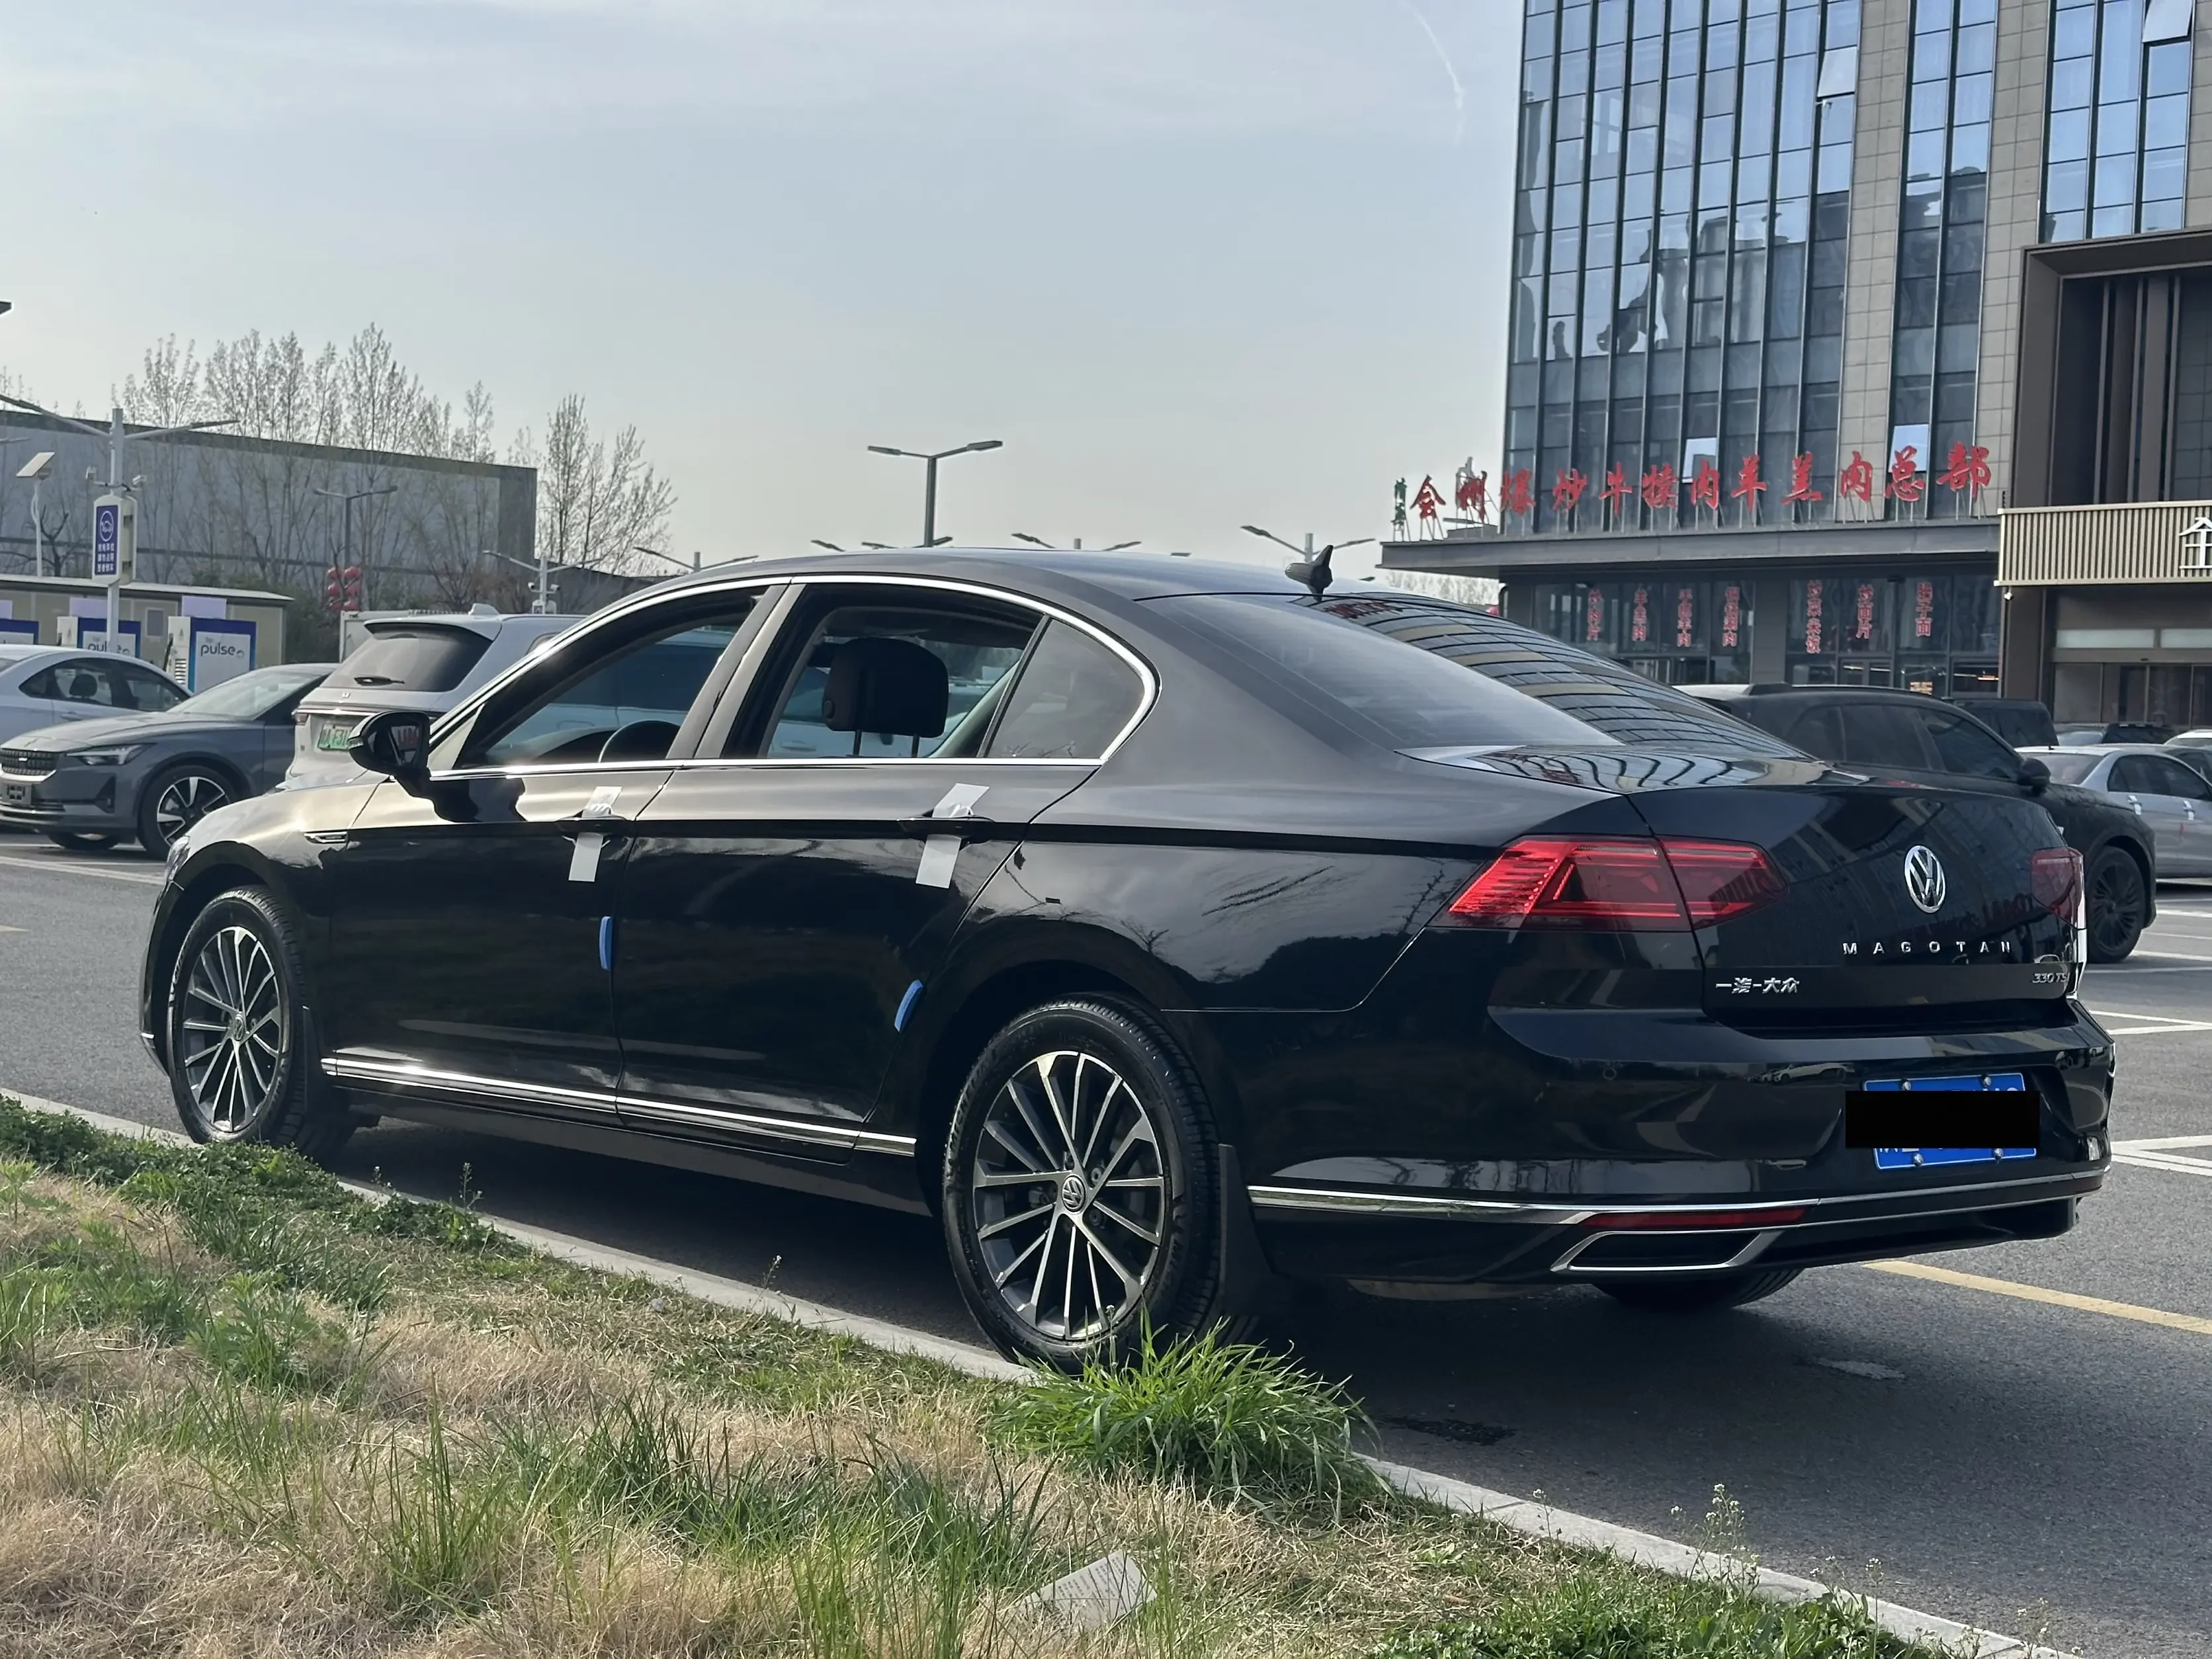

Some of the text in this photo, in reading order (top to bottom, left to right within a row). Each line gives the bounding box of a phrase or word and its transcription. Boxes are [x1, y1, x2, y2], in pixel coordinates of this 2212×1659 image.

[200, 642, 235, 657] pulse
[1842, 941, 2010, 955] MAGOTAN
[2032, 973, 2054, 983] 330
